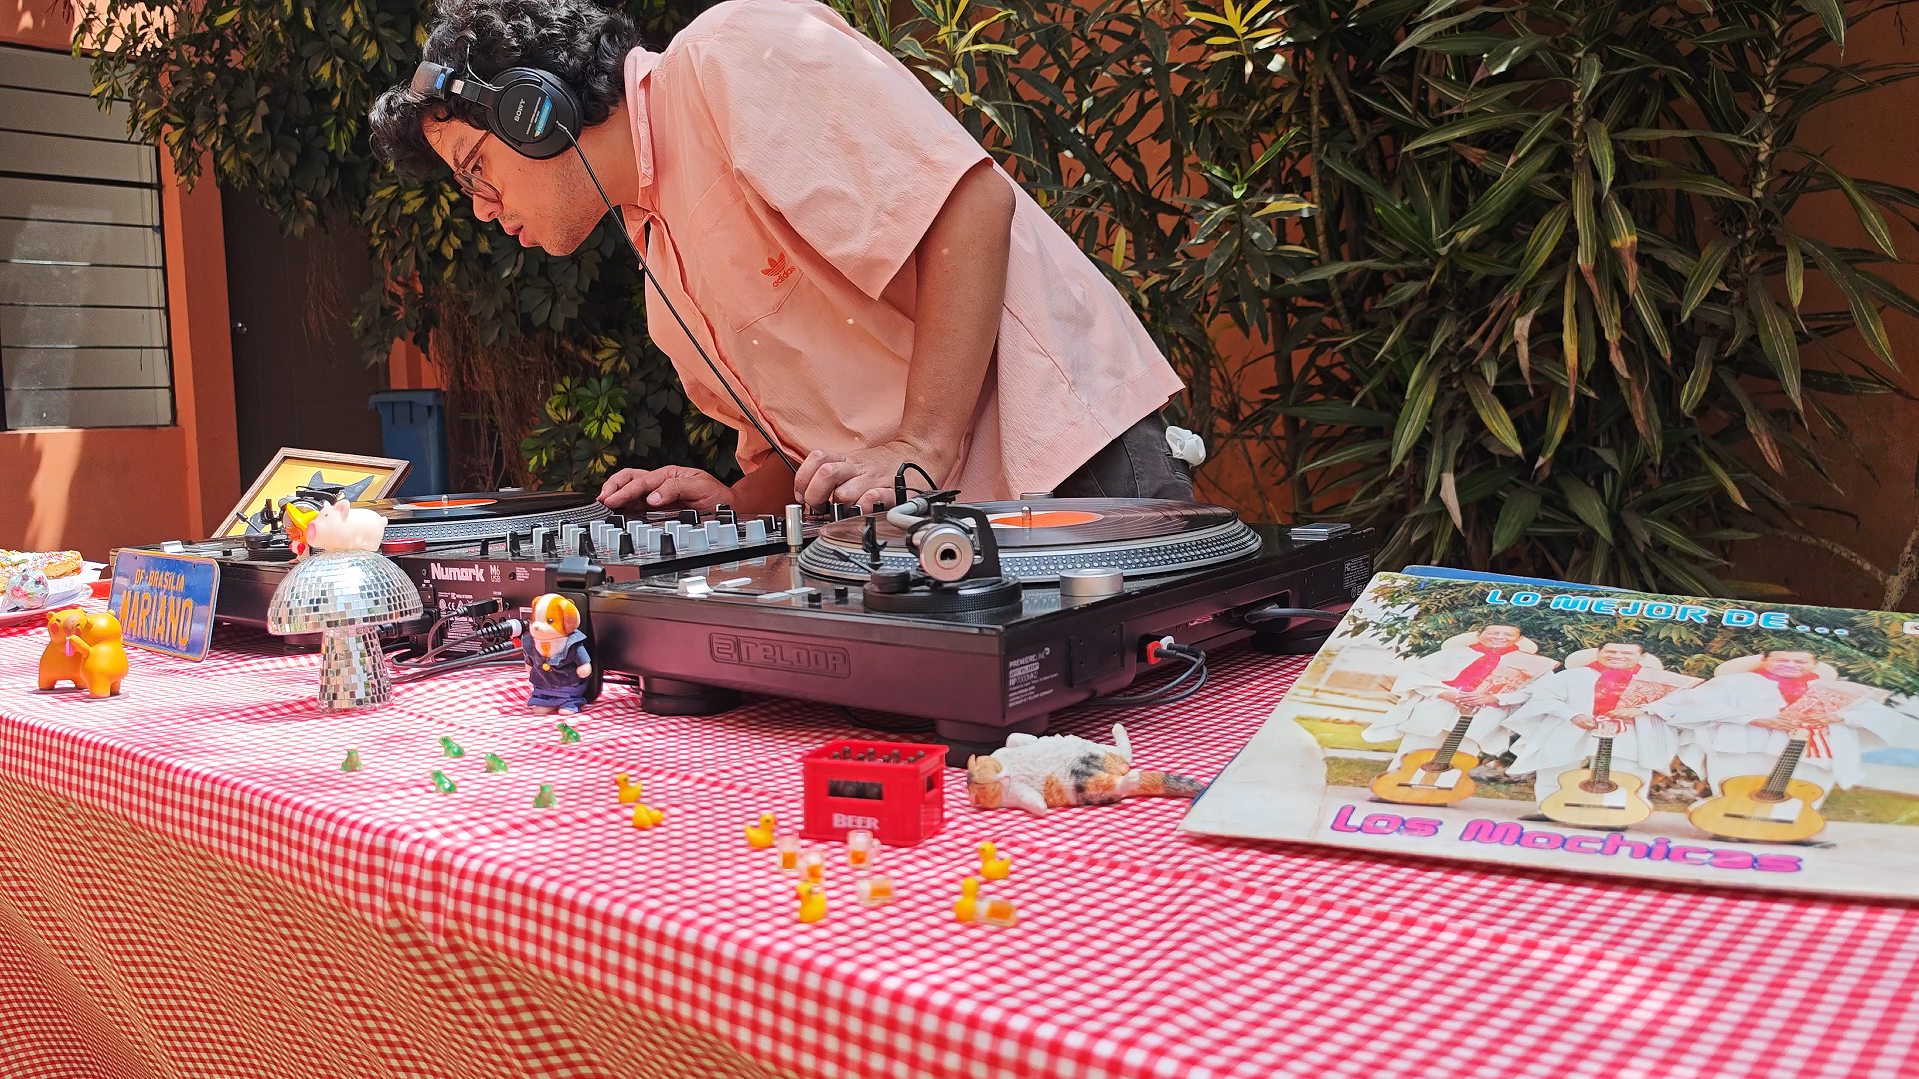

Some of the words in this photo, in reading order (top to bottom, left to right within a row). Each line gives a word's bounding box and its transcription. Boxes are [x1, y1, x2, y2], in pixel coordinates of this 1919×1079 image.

[514, 99, 526, 122] SONY
[772, 266, 796, 287] adidas
[430, 562, 485, 582] Numark
[489, 565, 501, 575] M6
[1485, 588, 1541, 607] LO
[1550, 594, 1709, 624] MEJOR
[119, 589, 194, 647] MARIANO
[832, 812, 881, 830] BEER
[1330, 804, 1444, 837] Los
[1459, 817, 1804, 874] Mochicas
